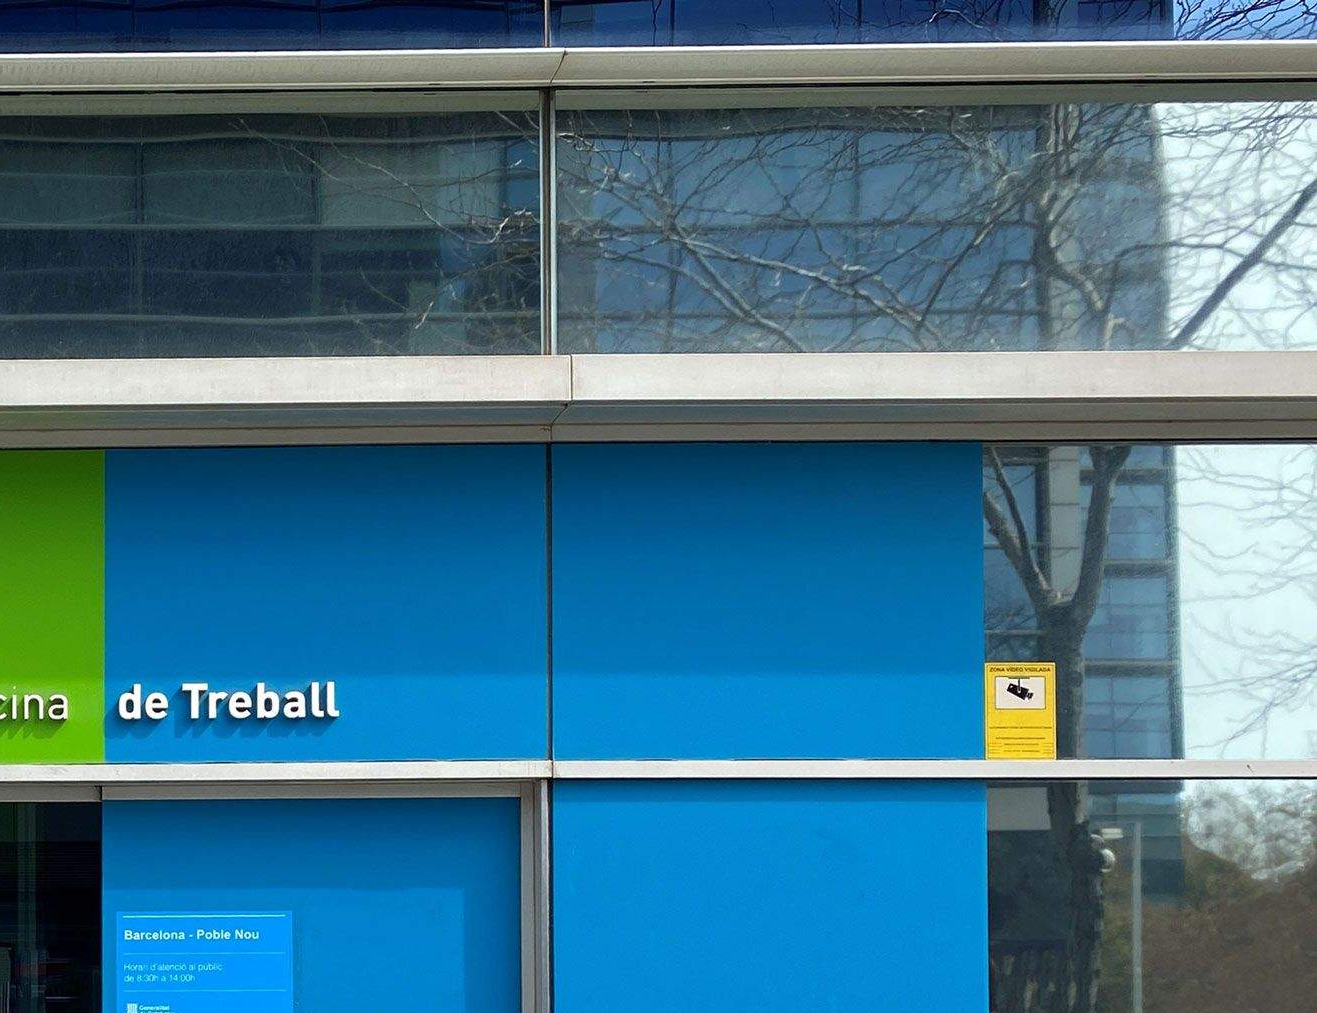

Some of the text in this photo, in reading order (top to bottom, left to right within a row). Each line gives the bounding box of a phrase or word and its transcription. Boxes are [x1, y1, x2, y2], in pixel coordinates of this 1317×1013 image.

[118, 684, 169, 720] de
[182, 681, 340, 720] Treball
[124, 930, 185, 940] Barcelona
[196, 929, 231, 940] Poble
[235, 929, 259, 940] Nou
[124, 974, 134, 983] de
[161, 975, 167, 983] a
